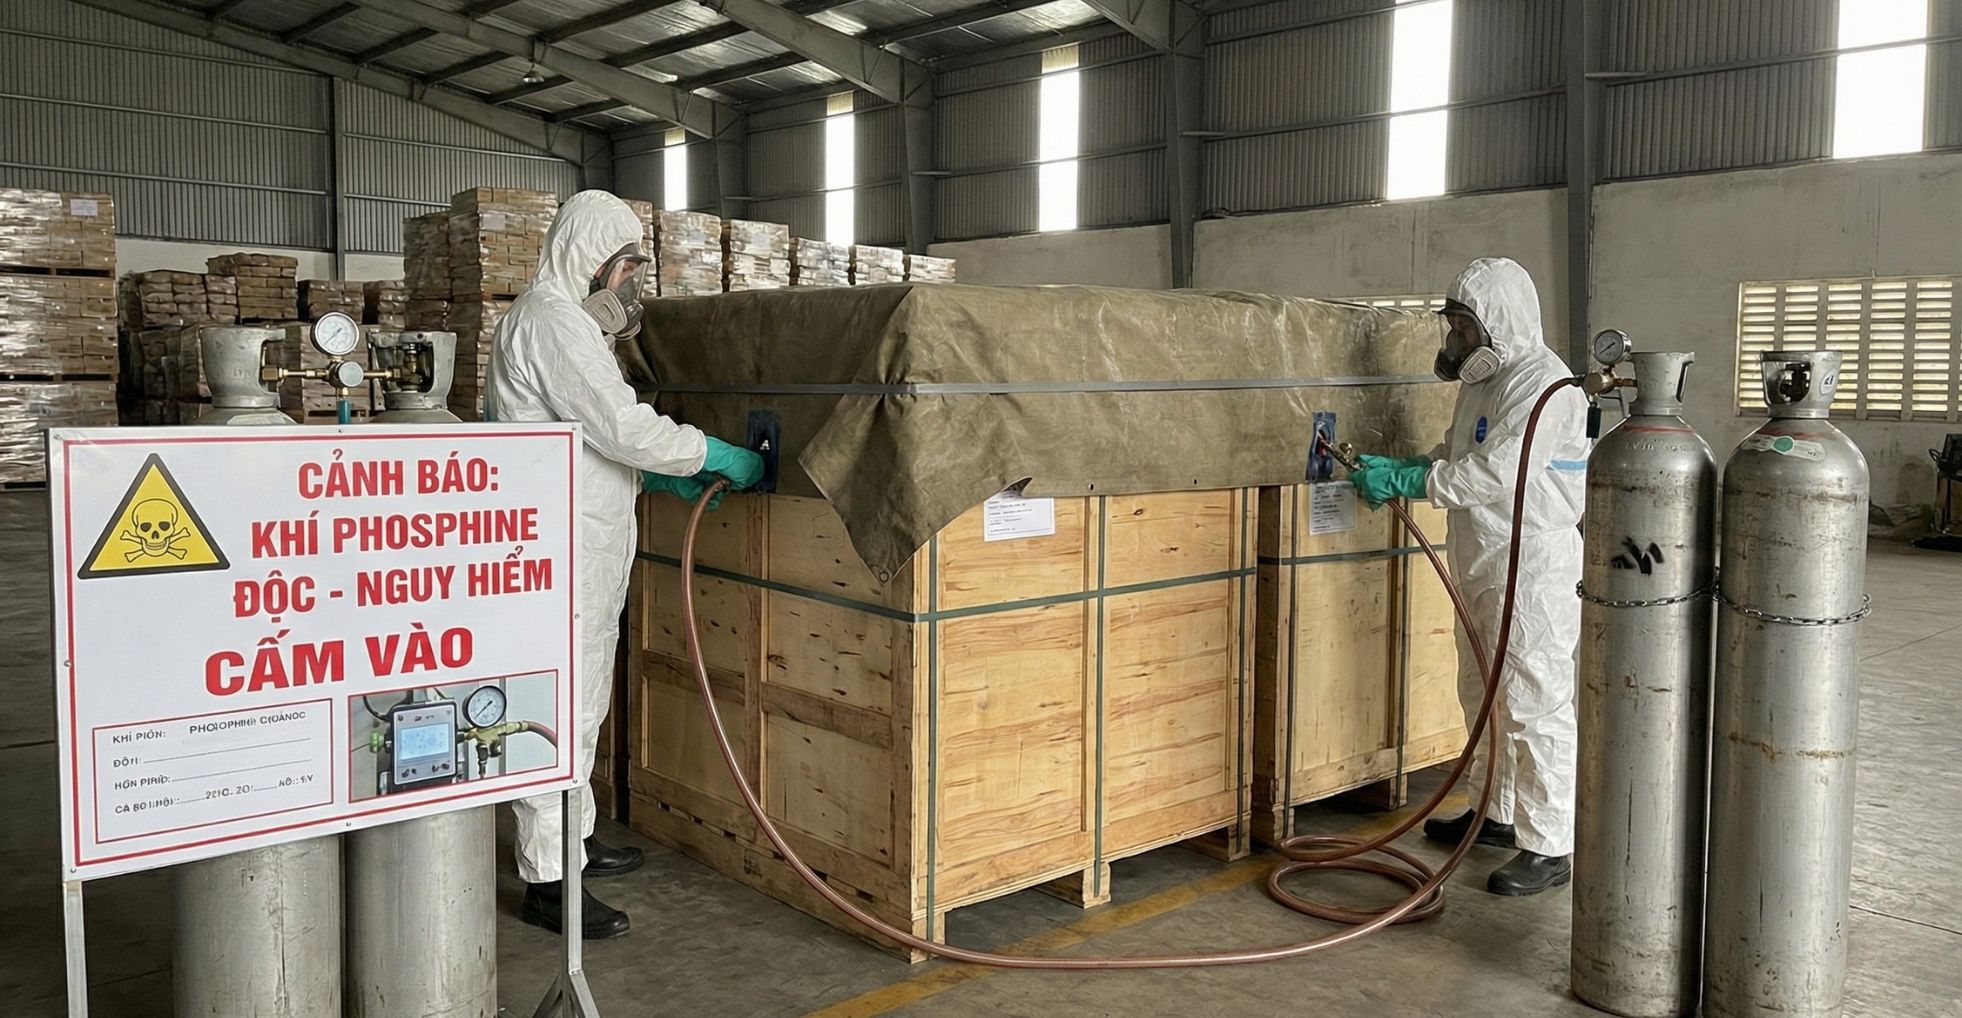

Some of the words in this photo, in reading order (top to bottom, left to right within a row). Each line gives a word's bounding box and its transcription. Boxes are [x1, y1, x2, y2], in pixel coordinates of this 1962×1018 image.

[299, 448, 404, 499] CẢNH
[417, 452, 498, 494] BÁO:
[252, 510, 318, 558] KHÍ
[333, 507, 539, 553] PHOSPHINE
[233, 570, 315, 623] ĐỘC
[357, 566, 455, 606] NGUY
[468, 545, 552, 596] HIỂM
[205, 630, 345, 696] CẤM
[365, 623, 473, 677] VÀO
